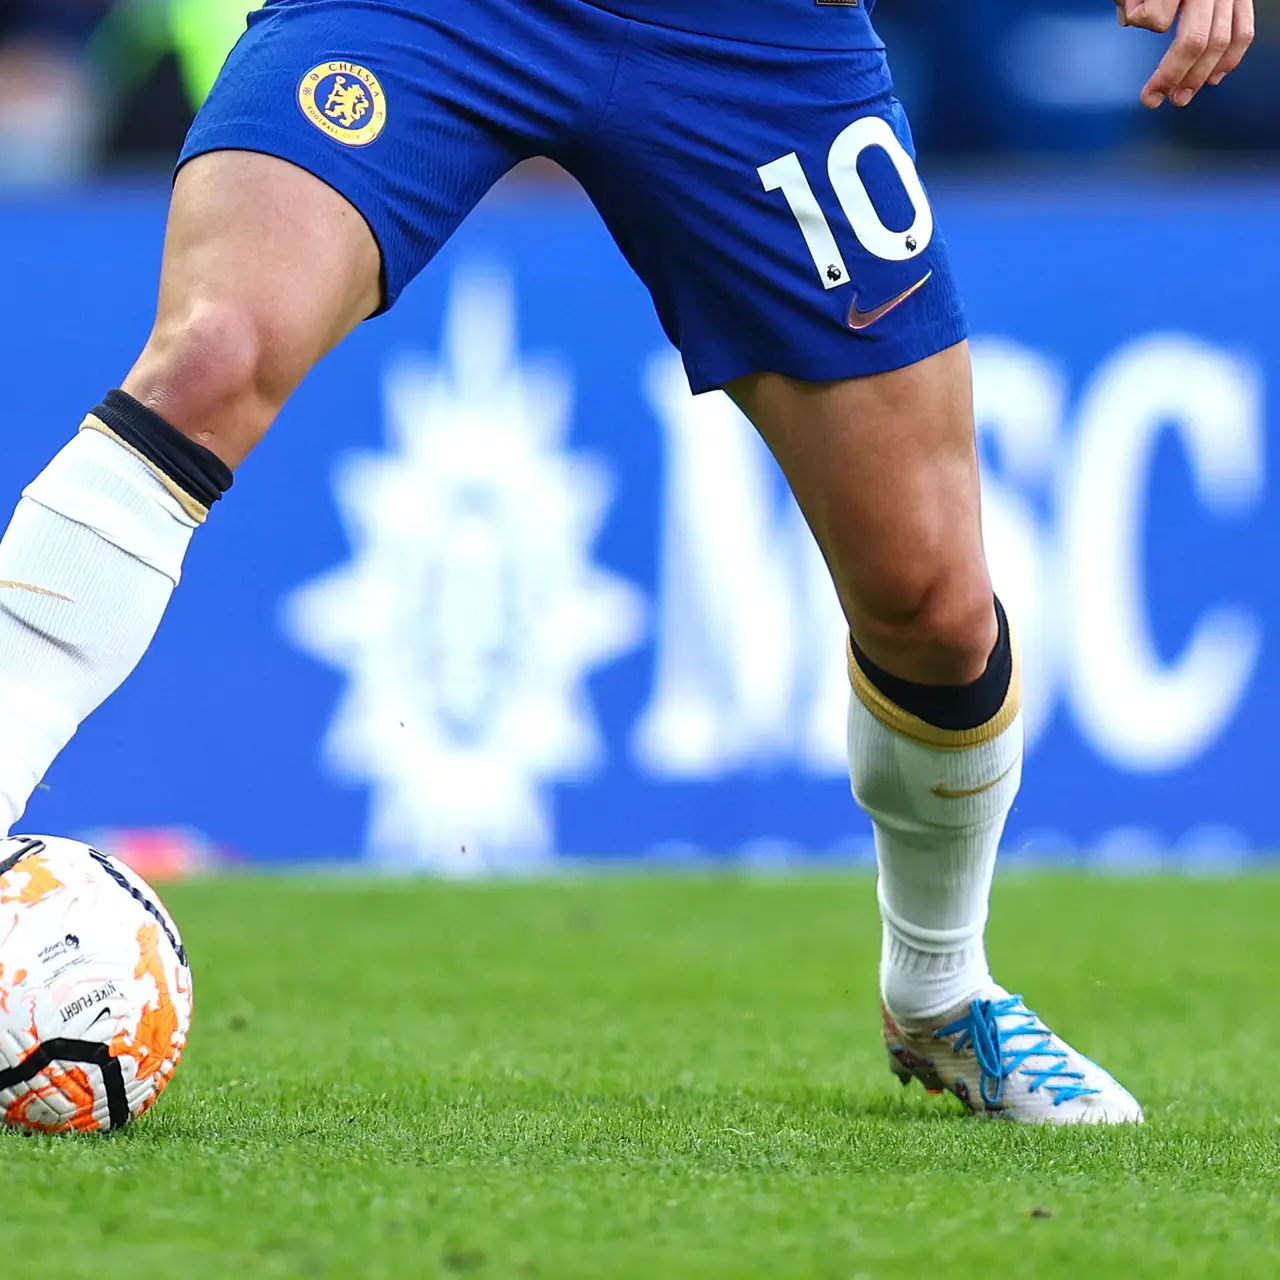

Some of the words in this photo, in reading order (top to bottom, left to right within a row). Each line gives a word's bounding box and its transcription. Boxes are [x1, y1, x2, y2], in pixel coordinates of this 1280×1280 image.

[328, 62, 380, 97] CHELSEA
[756, 116, 933, 290] 10
[92, 979, 116, 1002] NIKE
[59, 993, 93, 1023] FLIGHT
